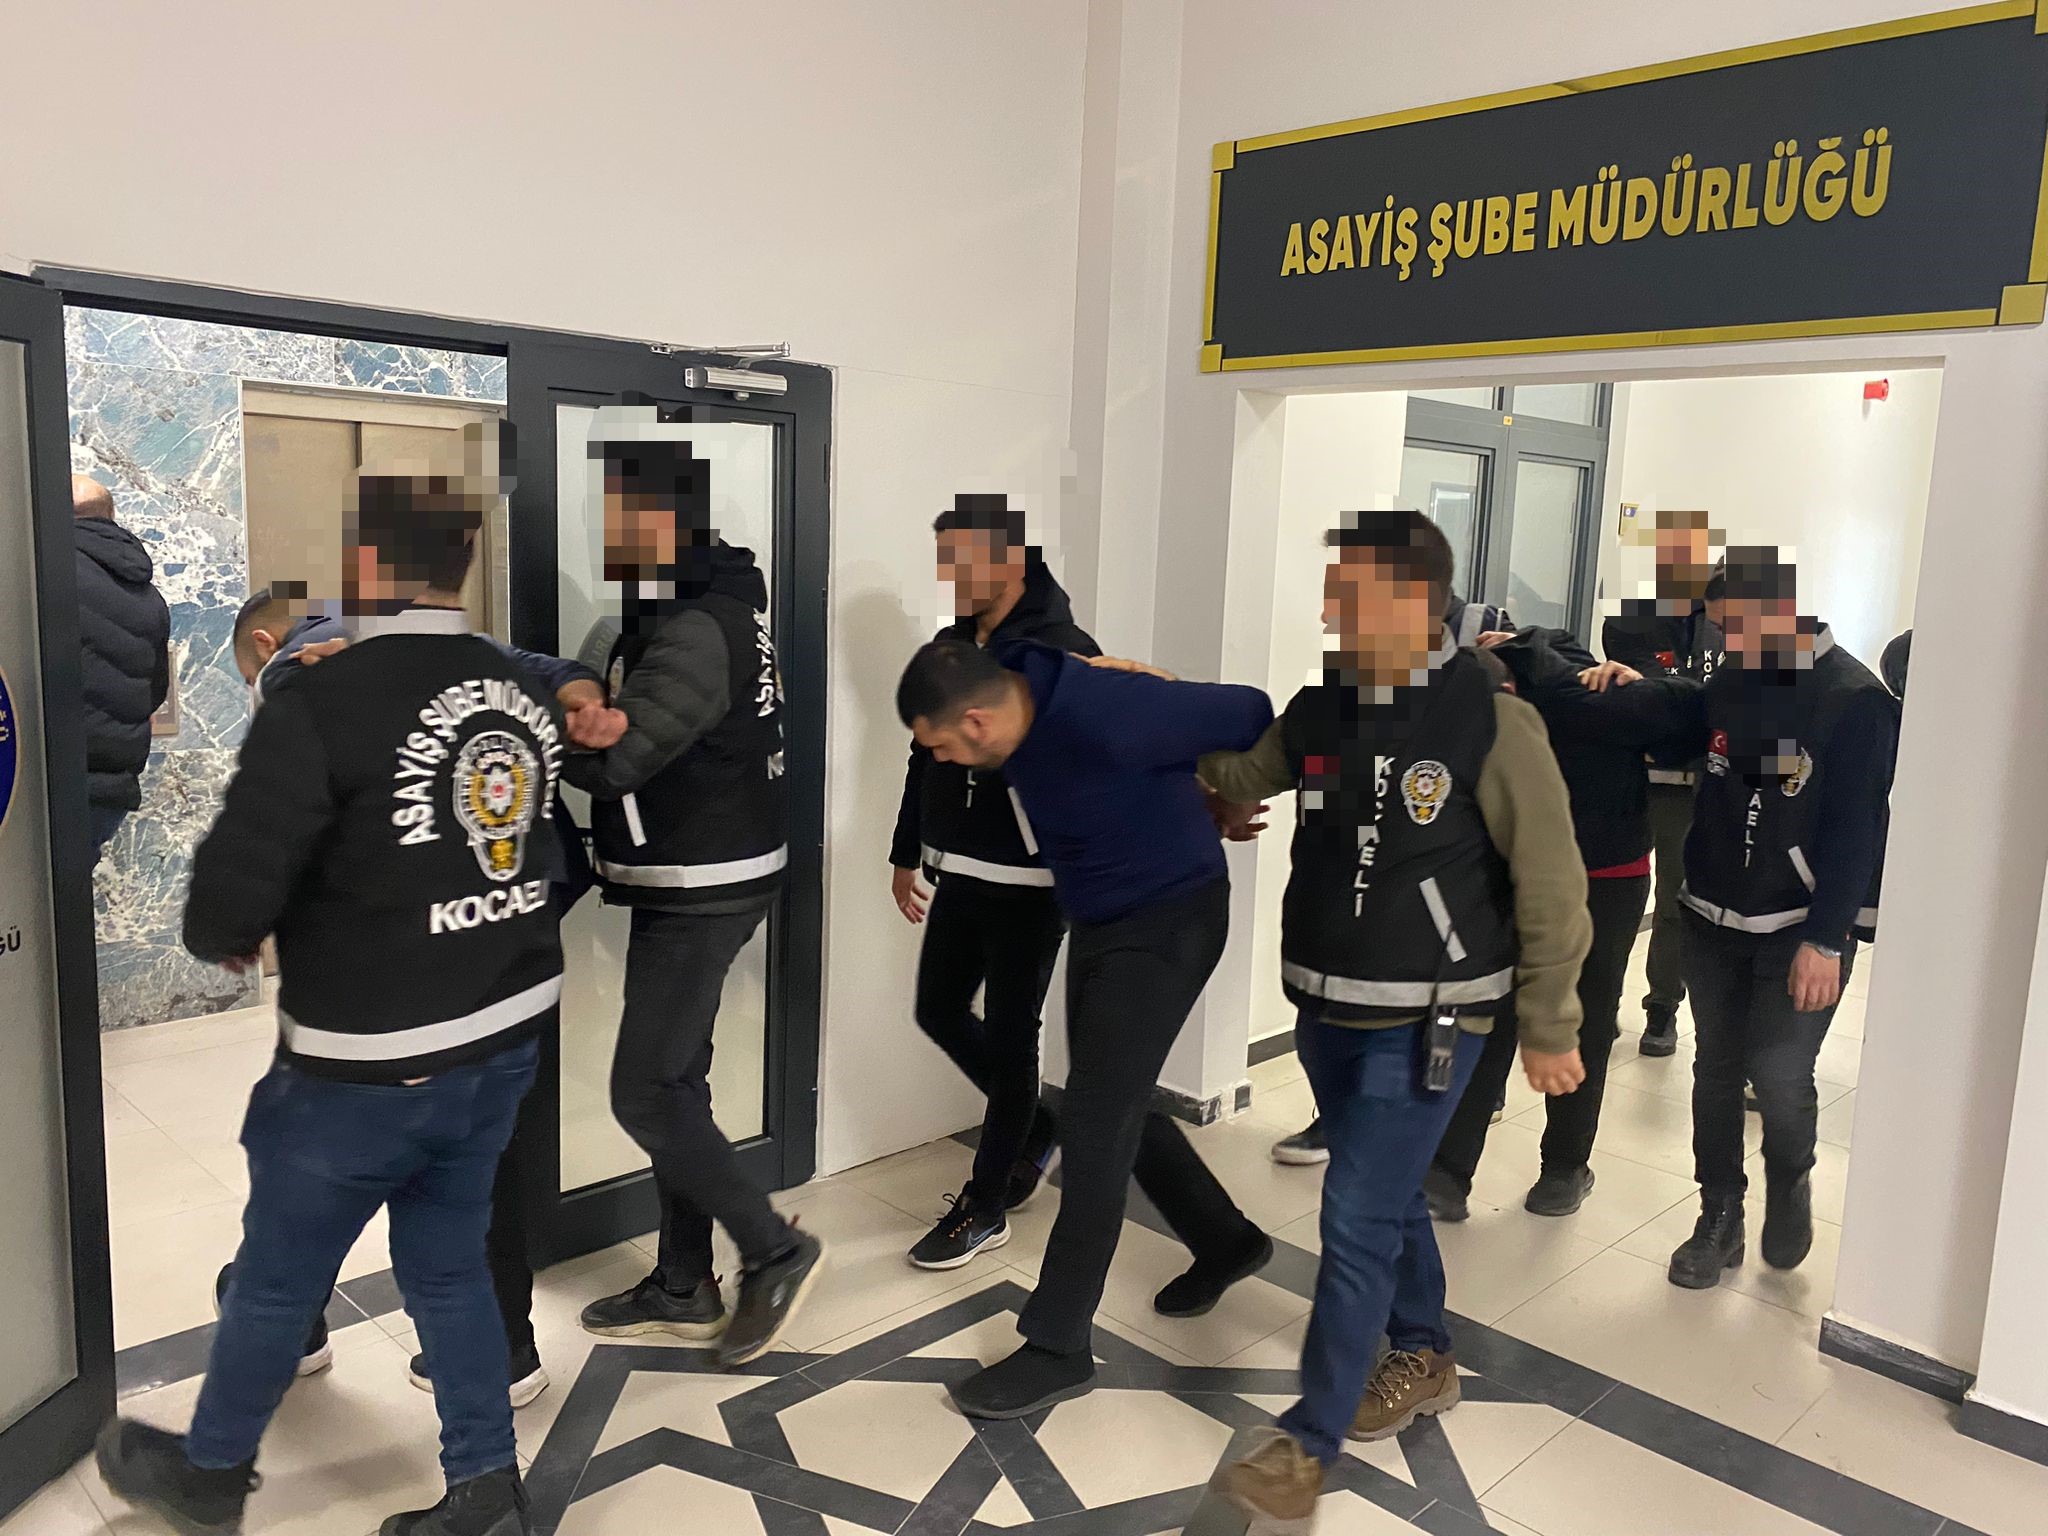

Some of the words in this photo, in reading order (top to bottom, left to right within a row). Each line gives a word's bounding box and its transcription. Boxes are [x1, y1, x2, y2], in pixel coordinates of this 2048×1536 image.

[1280, 194, 1419, 281] ASAYİŞ
[1427, 191, 1538, 278] ŞUBE
[1547, 127, 1893, 249] MÜDÜRLÜĞÜ
